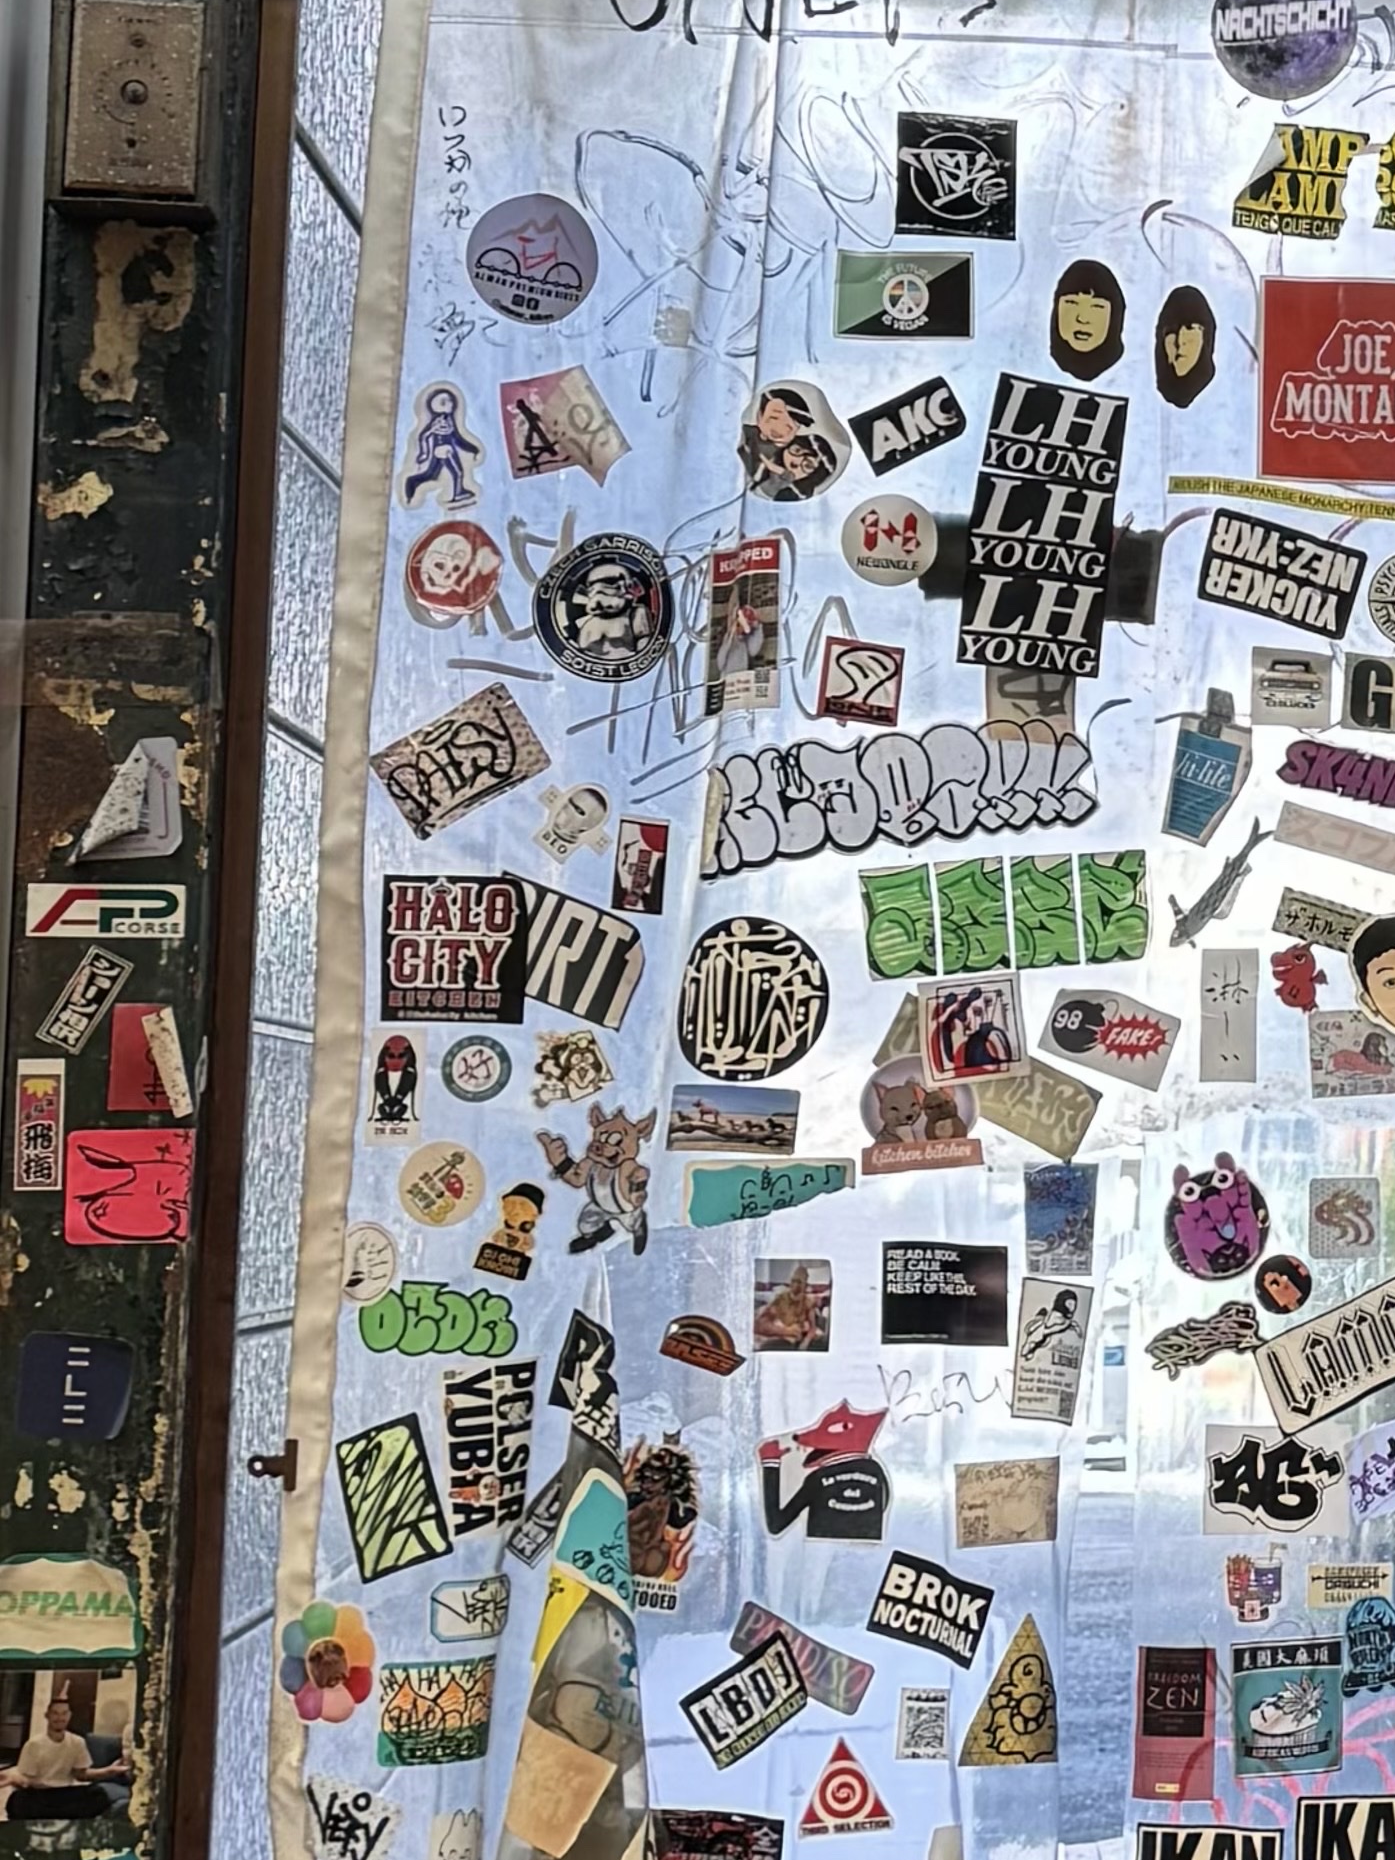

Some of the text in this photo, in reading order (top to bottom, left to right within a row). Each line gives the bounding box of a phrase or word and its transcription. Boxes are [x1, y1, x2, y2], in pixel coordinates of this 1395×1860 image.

[1216, 0, 1352, 41] NACHTSCHICHT
[1335, 334, 1392, 375] JOE
[988, 378, 1126, 456] LH
[984, 437, 1121, 486] YOUNG
[971, 476, 1115, 550] LH
[969, 537, 1107, 580] YOUNG
[961, 573, 1105, 648] LH
[960, 634, 1097, 676] YOUNG
[115, 920, 181, 935] CORSE
[389, 880, 520, 935] HALO
[388, 938, 511, 990] CITY
[1053, 1008, 1083, 1030] 98
[1104, 1027, 1164, 1052] FAKE!
[883, 1564, 987, 1630] BROK
[874, 1599, 975, 1660] NOCTURNAL
[1145, 1686, 1199, 1710] ZEN
[833, 1818, 892, 1833] SELECTION
